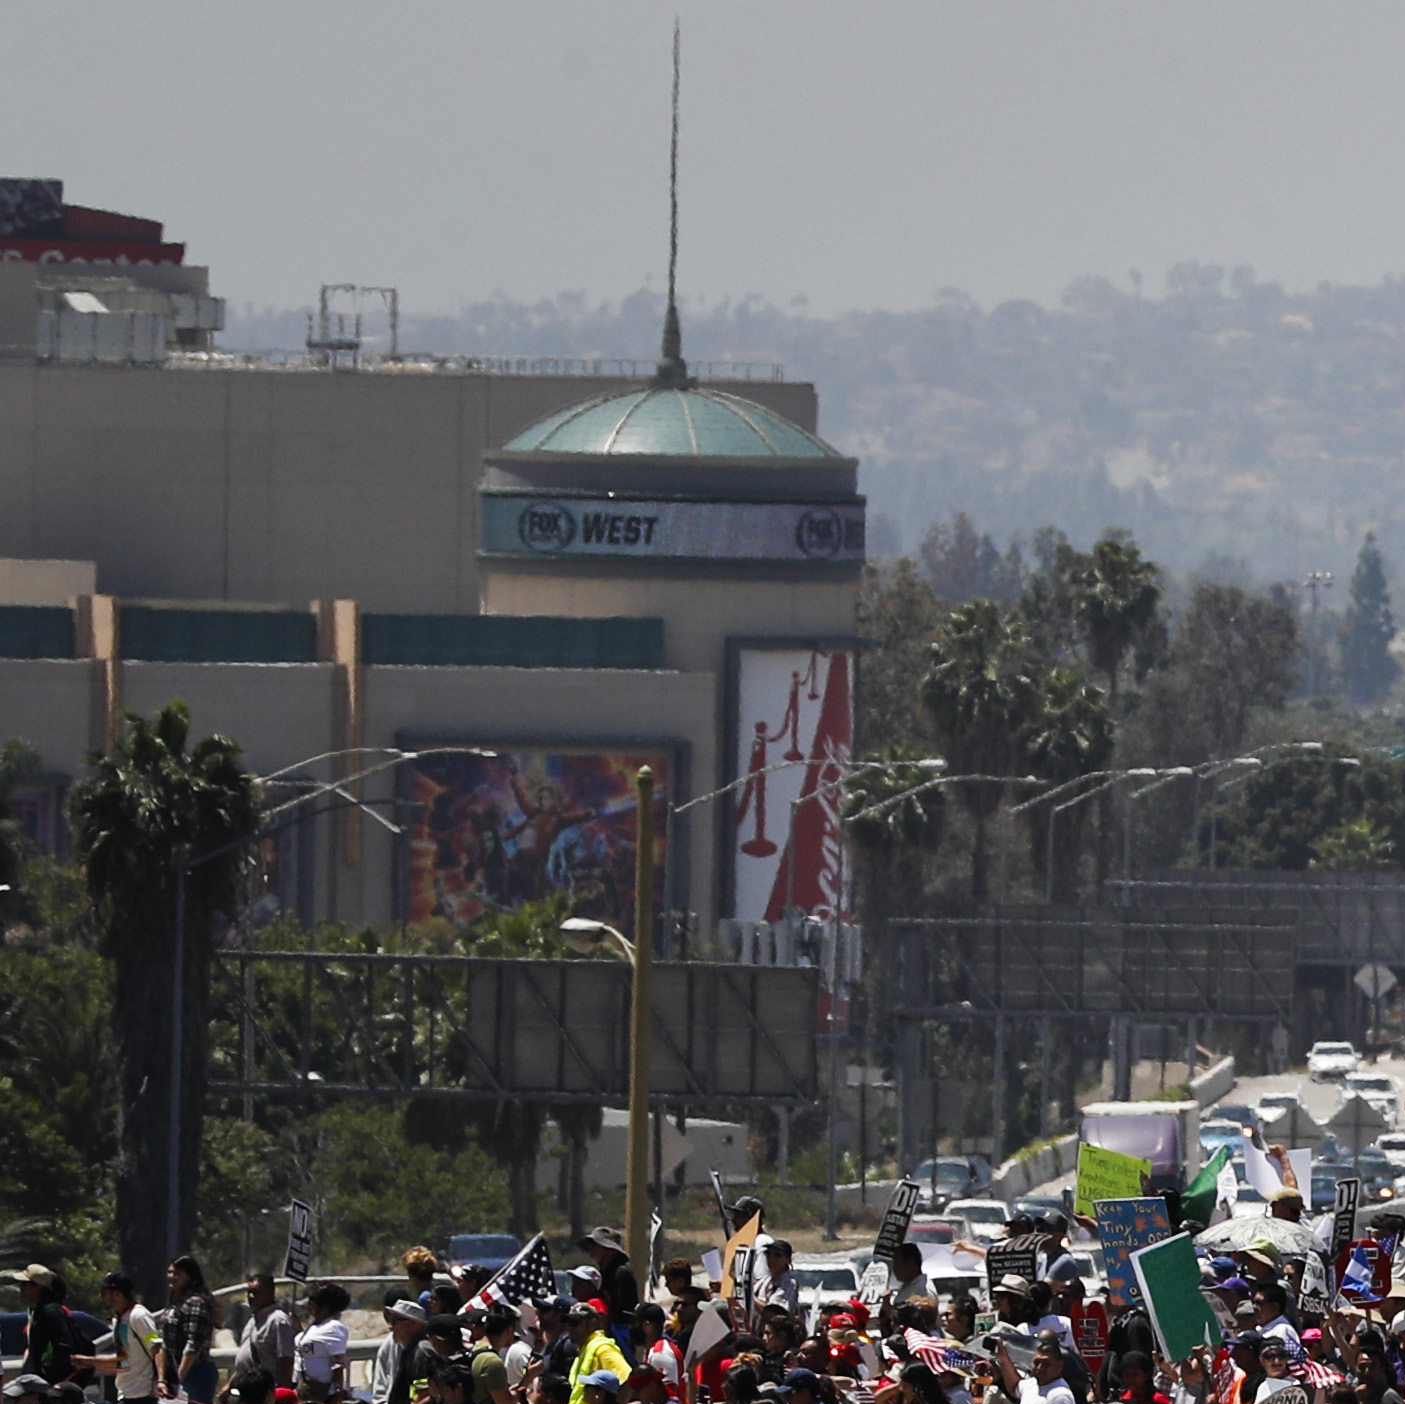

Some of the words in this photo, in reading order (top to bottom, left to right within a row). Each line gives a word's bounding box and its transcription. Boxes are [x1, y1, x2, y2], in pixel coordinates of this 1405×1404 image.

[528, 511, 562, 533] FOX
[582, 513, 659, 545] WEST
[1095, 1202, 1123, 1218] Keep
[1132, 1201, 1158, 1214] Your
[1101, 1220, 1133, 1237] Tiny
[1102, 1235, 1139, 1249] hands
[1106, 1257, 1121, 1270] My
